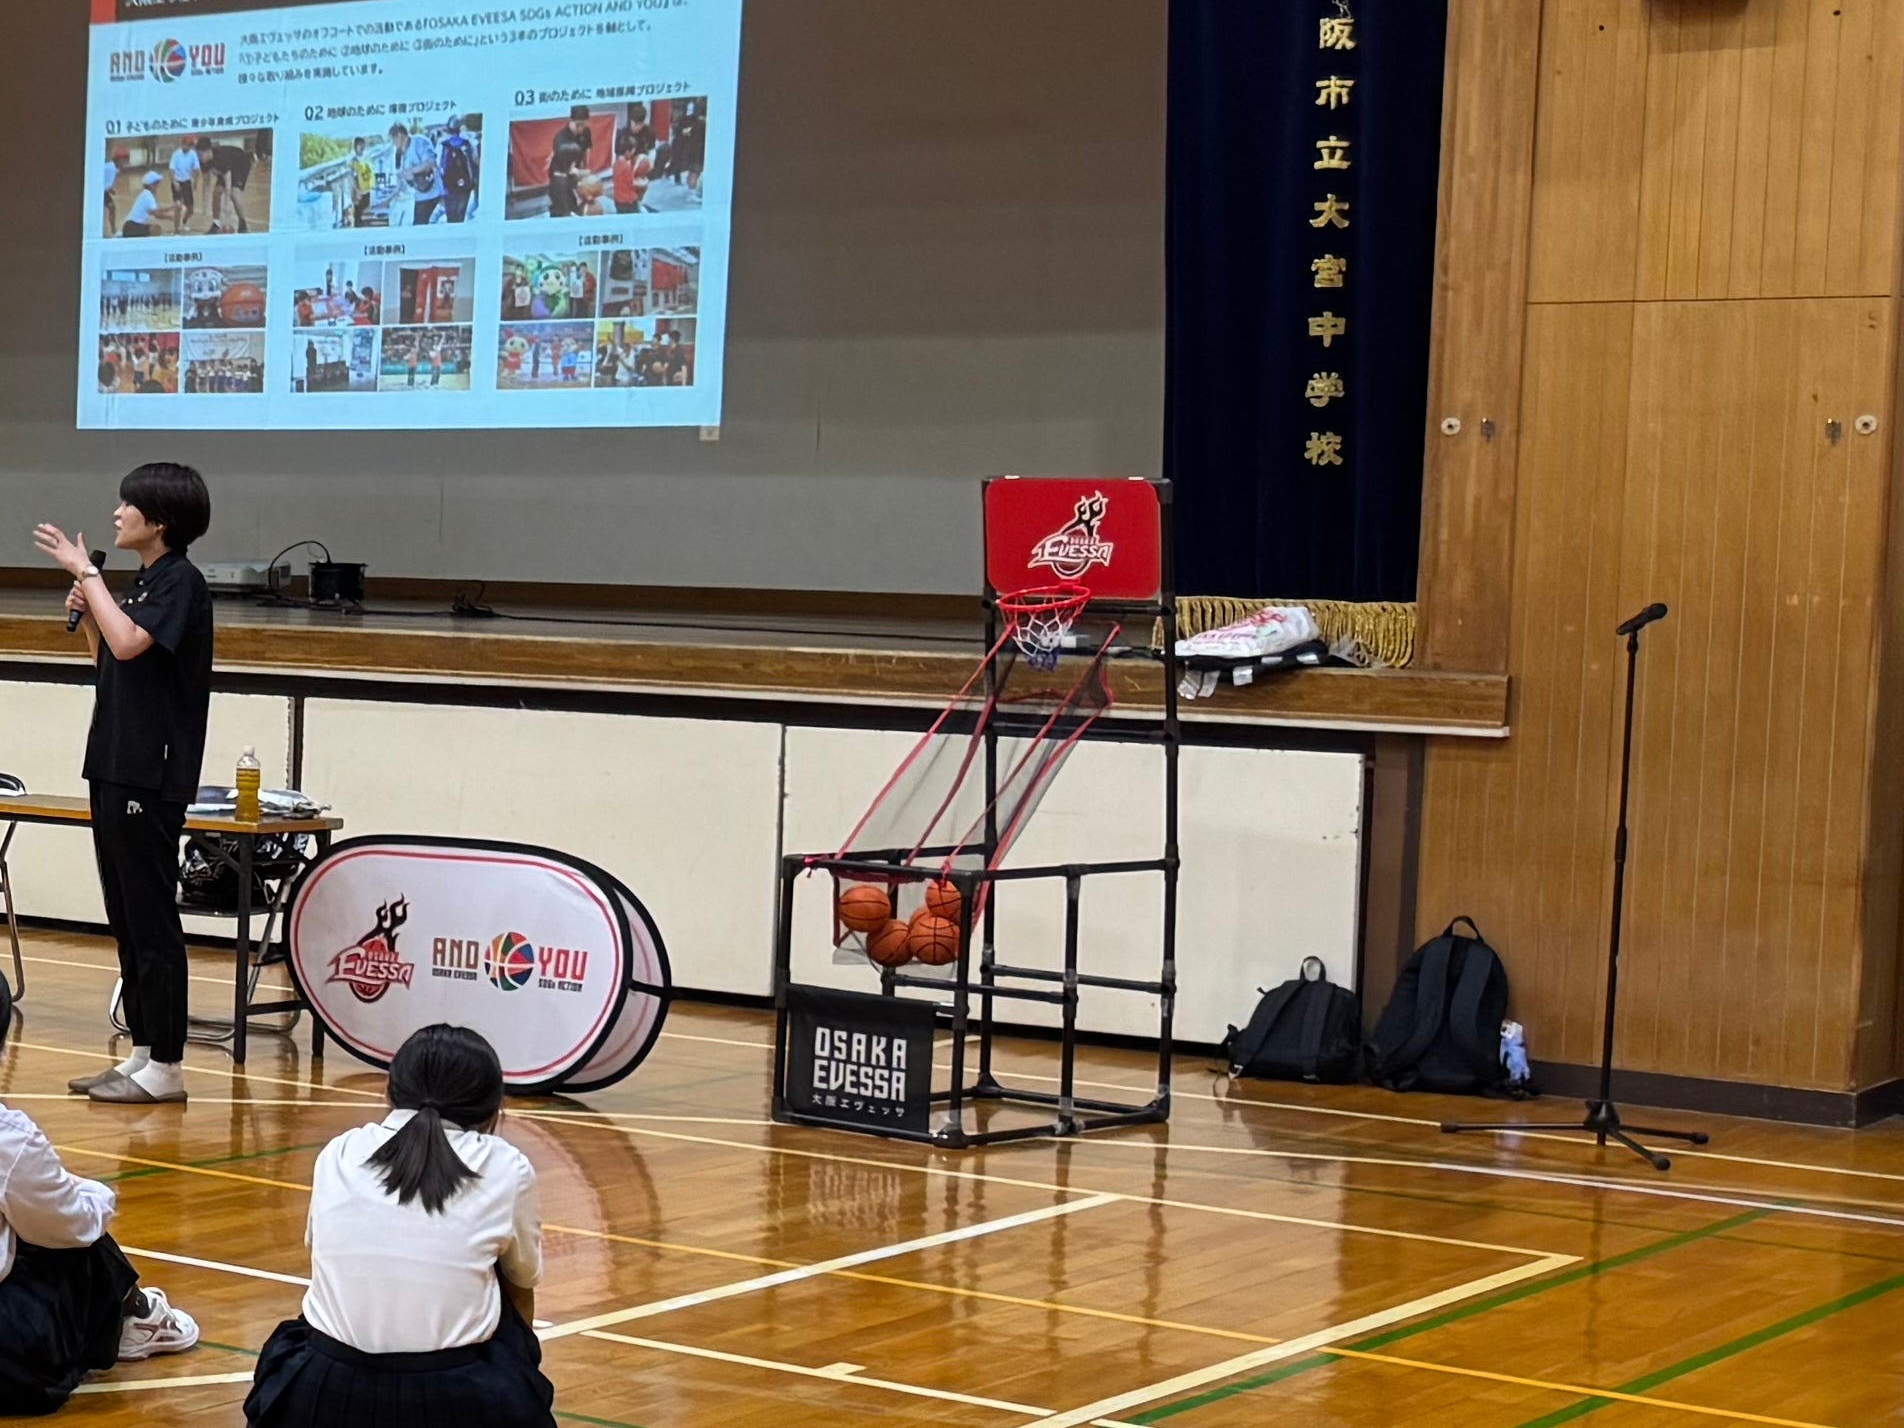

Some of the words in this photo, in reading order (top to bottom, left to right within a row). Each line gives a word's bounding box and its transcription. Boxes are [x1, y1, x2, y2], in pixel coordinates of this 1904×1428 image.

[554, 2, 603, 18] ACTION
[605, 0, 632, 13] AND
[110, 50, 145, 75] AND
[189, 42, 225, 68] YOU
[515, 90, 535, 106] 03
[305, 106, 323, 121] 02
[1040, 535, 1109, 560] EVESSA
[335, 946, 412, 983] EVESSA
[432, 938, 479, 970] AND
[539, 947, 588, 981] YOU
[814, 1026, 907, 1070] OSAKA
[813, 1059, 906, 1102] EVESSA
[812, 1094, 905, 1118] 大阪エヴェッサ
